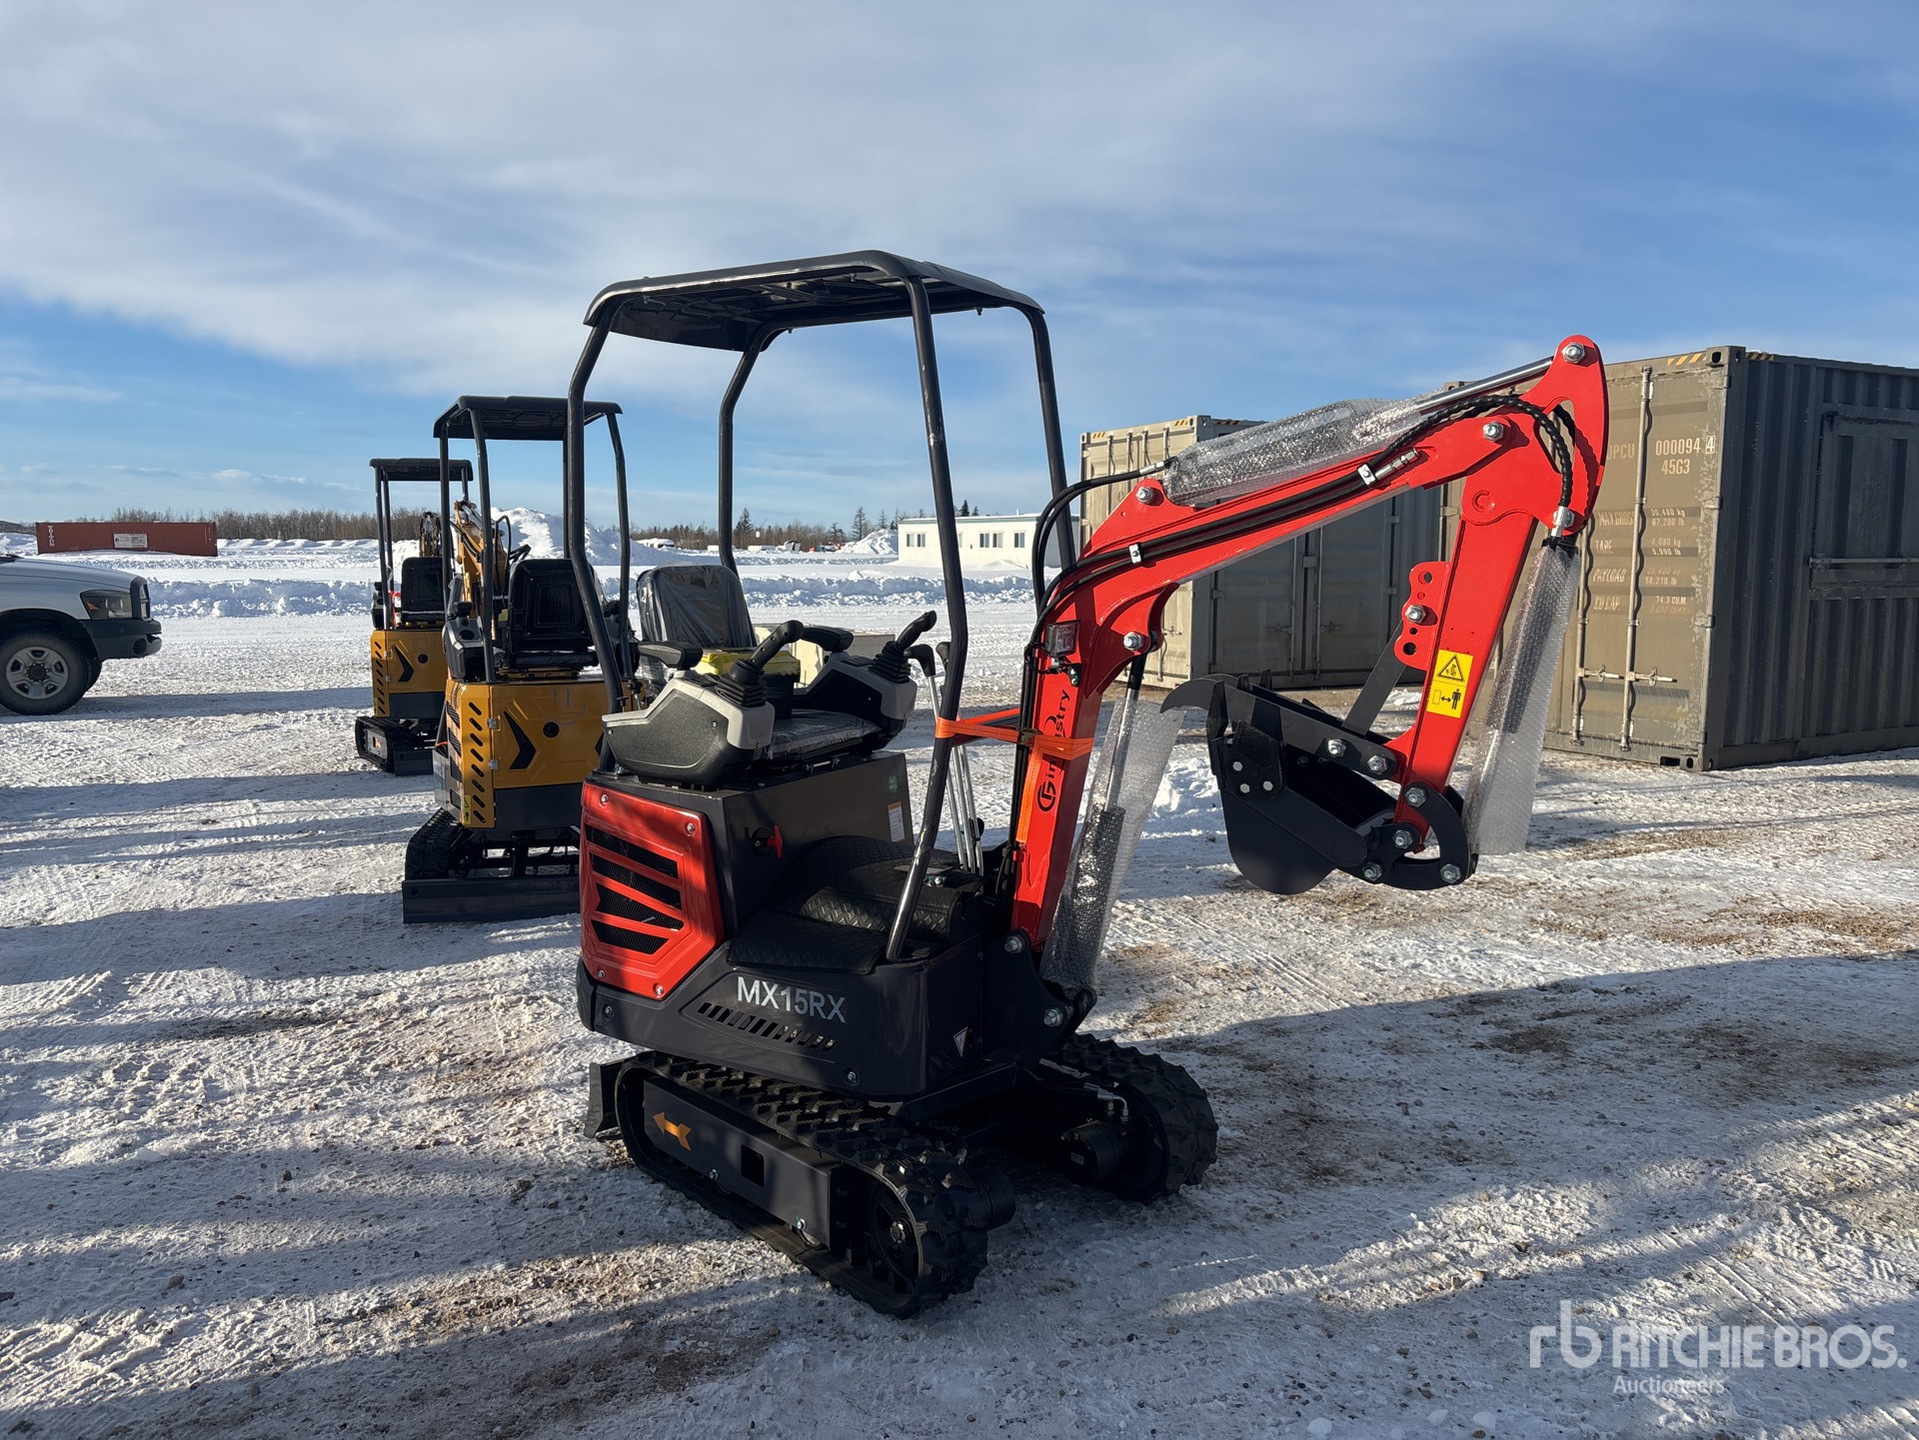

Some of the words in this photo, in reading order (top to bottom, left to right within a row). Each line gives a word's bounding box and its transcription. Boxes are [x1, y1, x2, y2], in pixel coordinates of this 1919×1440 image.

[1655, 438, 1701, 456] 000094
[1705, 436, 1715, 454] 4
[1661, 459, 1690, 475] 45G3
[737, 976, 846, 1024] MX15RX
